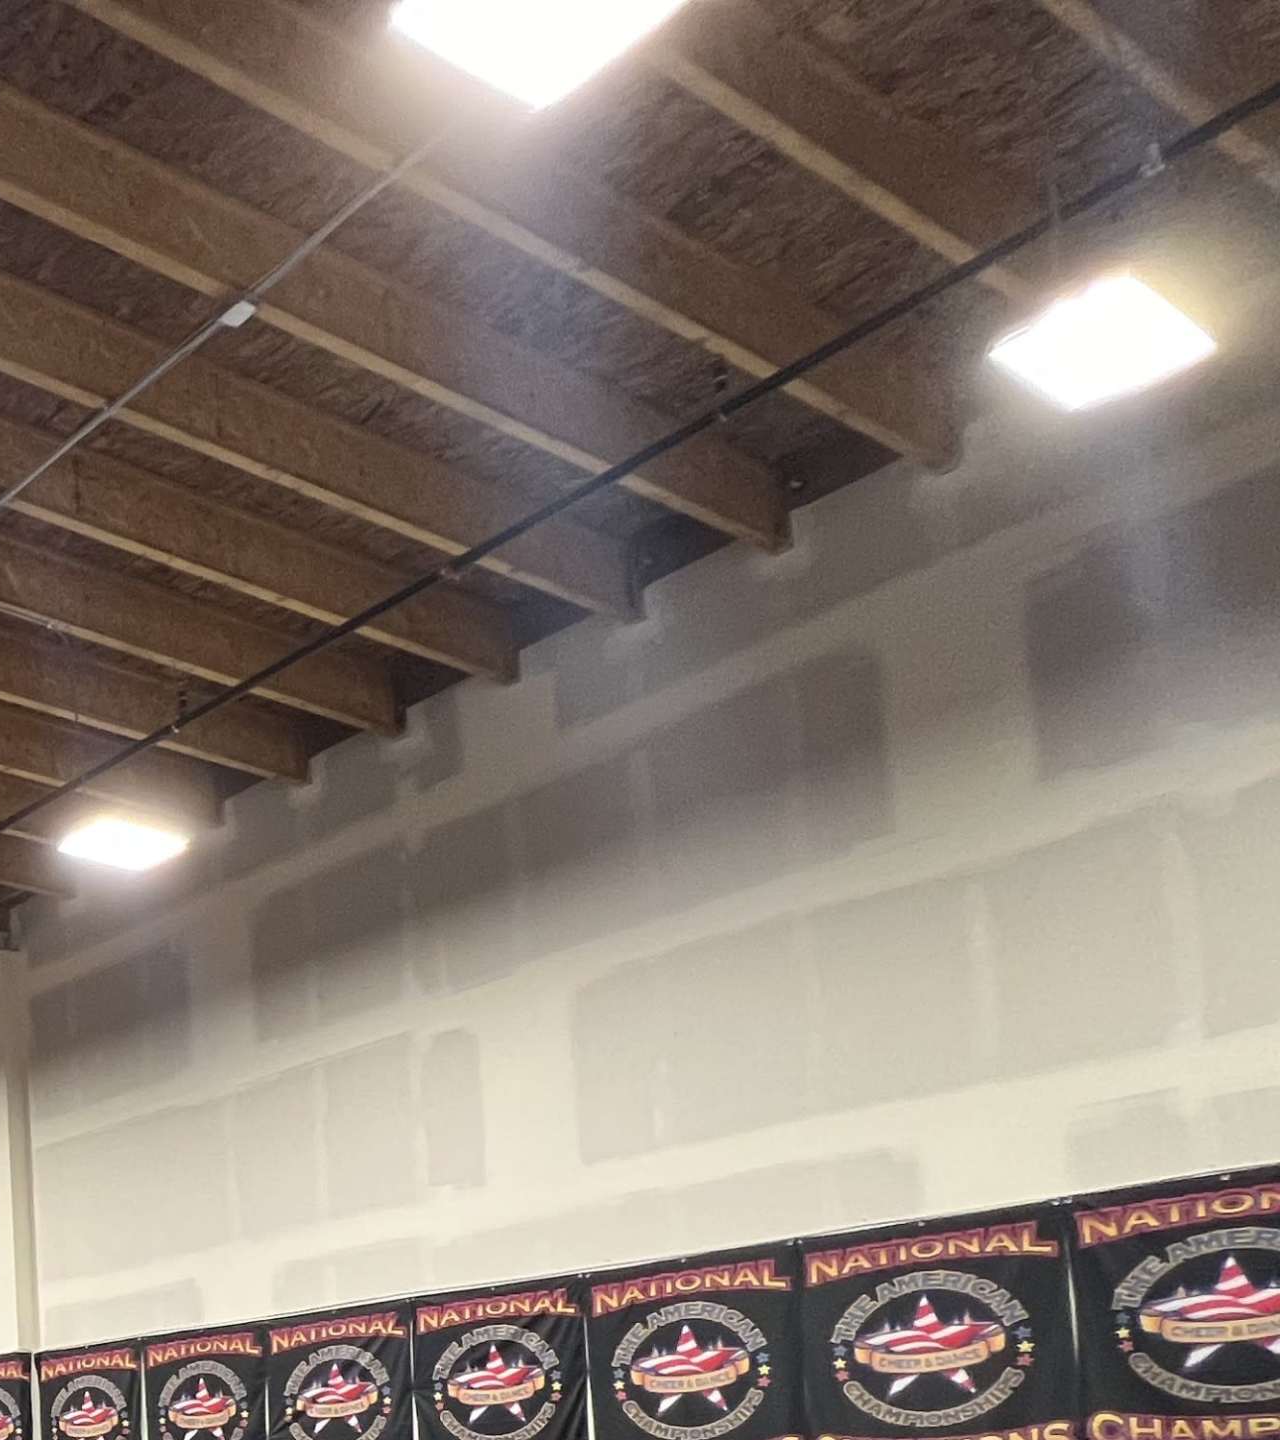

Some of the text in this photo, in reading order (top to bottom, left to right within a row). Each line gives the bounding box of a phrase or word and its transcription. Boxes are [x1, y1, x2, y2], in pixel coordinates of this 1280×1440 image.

[808, 1229, 1054, 1284] NATIONAL
[418, 1294, 576, 1335] NATIONAL
[596, 1267, 788, 1314] NATIONAL
[831, 1269, 1029, 1344] THE AMERICAN
[148, 1337, 262, 1368] NATIONAL
[271, 1319, 404, 1355] NATIONAL
[612, 1301, 768, 1367] THE AMERICAN
[41, 1353, 137, 1382] NATIONAL
[622, 1388, 764, 1440] CHAMPIONSHIPS
[843, 1366, 1025, 1427] CHAMPIONSHIPS
